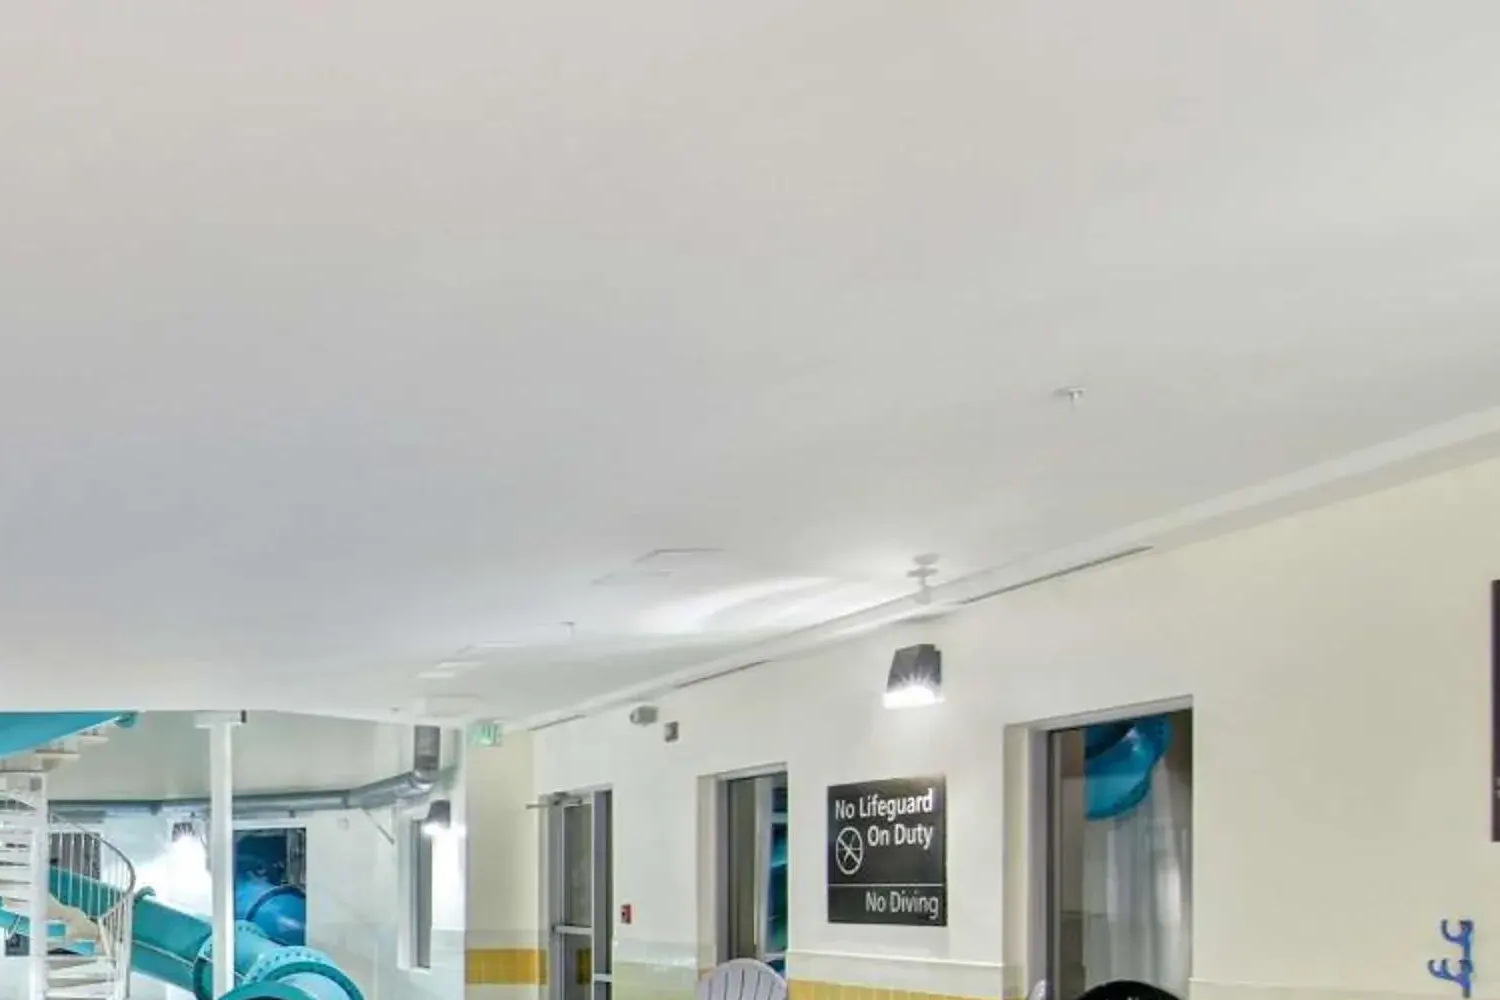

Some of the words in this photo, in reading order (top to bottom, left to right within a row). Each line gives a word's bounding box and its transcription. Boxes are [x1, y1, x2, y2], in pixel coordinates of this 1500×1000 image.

[835, 799, 854, 819] No
[859, 788, 933, 821] Lifeguard
[867, 825, 889, 846] On
[894, 824, 933, 849] Duty
[865, 891, 886, 912] No
[889, 889, 939, 919] Diving
